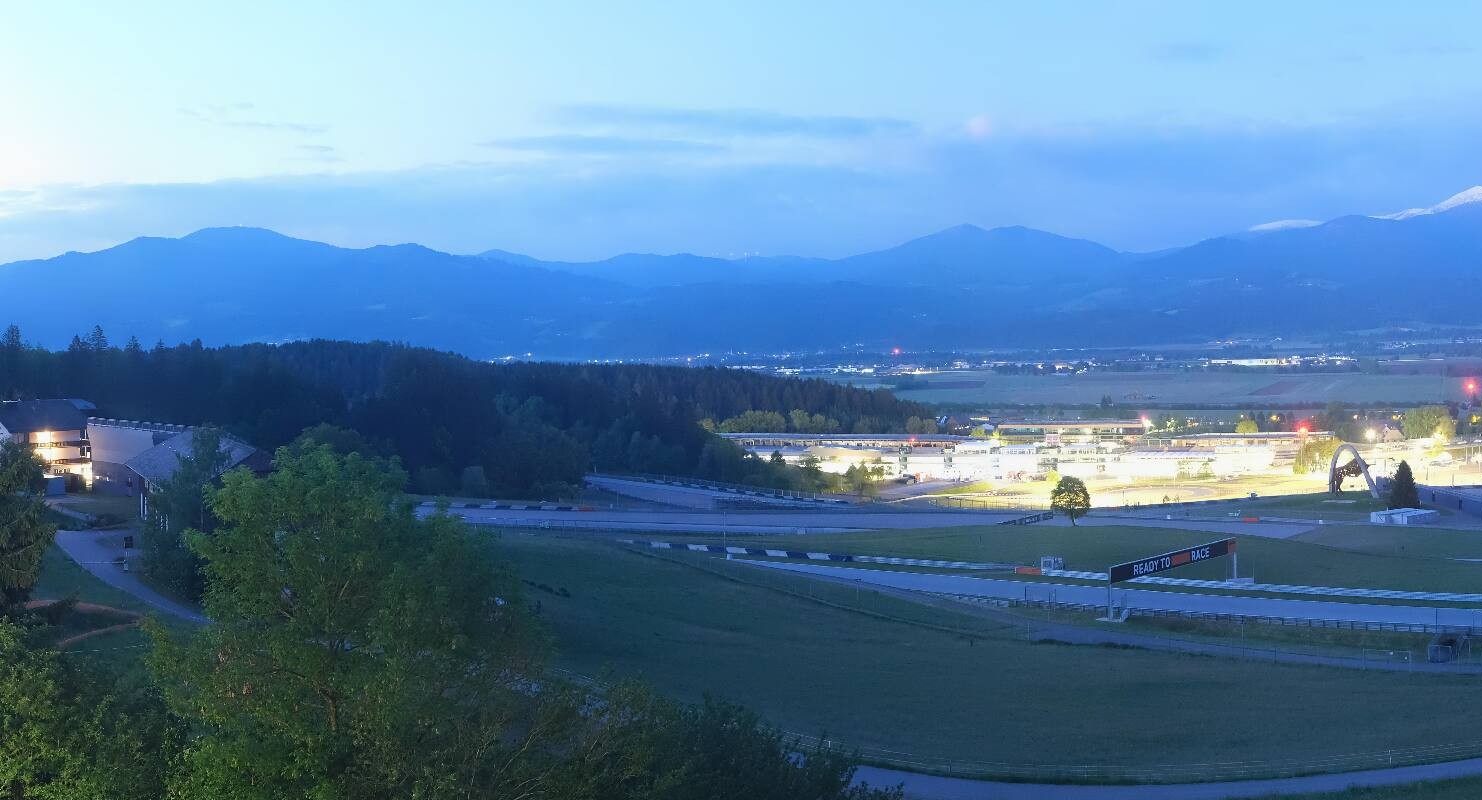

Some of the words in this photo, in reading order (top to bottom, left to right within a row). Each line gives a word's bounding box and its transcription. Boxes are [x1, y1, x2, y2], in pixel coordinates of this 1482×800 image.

[1133, 560, 1159, 575] READY
[1160, 557, 1171, 569] TO
[1191, 547, 1210, 561] RACE
